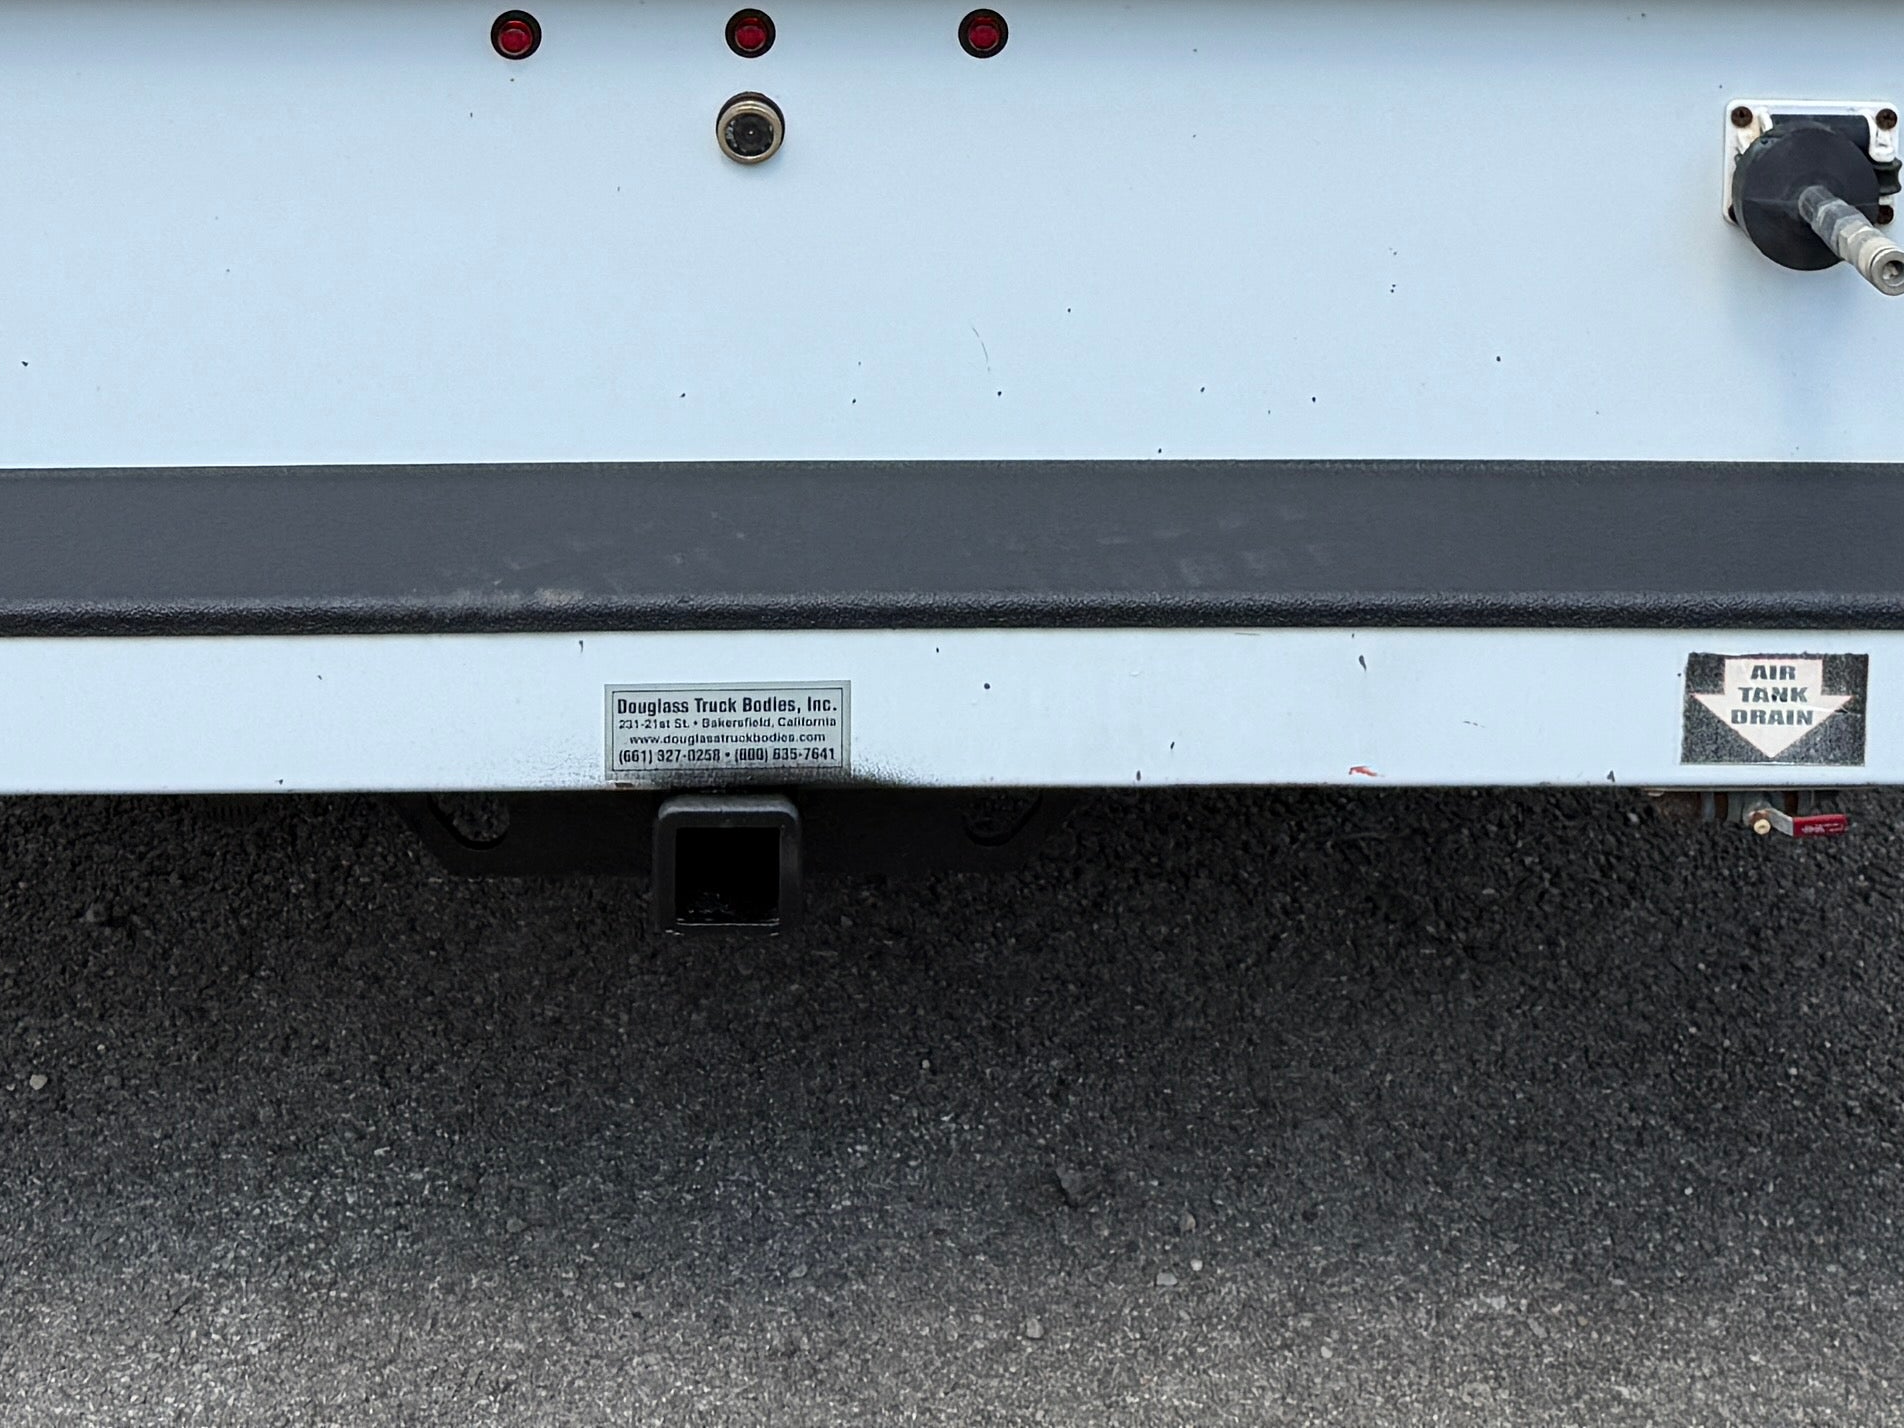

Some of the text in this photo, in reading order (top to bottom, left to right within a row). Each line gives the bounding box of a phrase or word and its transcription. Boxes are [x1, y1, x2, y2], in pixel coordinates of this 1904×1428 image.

[1750, 664, 1797, 681] AIR
[1737, 686, 1808, 703] TANK
[617, 696, 838, 717] Douglass Truck Bodies, Inc.
[702, 717, 775, 729] Bakersfield,
[777, 716, 837, 728] California
[1730, 708, 1814, 726] DRAIN
[629, 732, 826, 746] www.douglasstruckbodies.com
